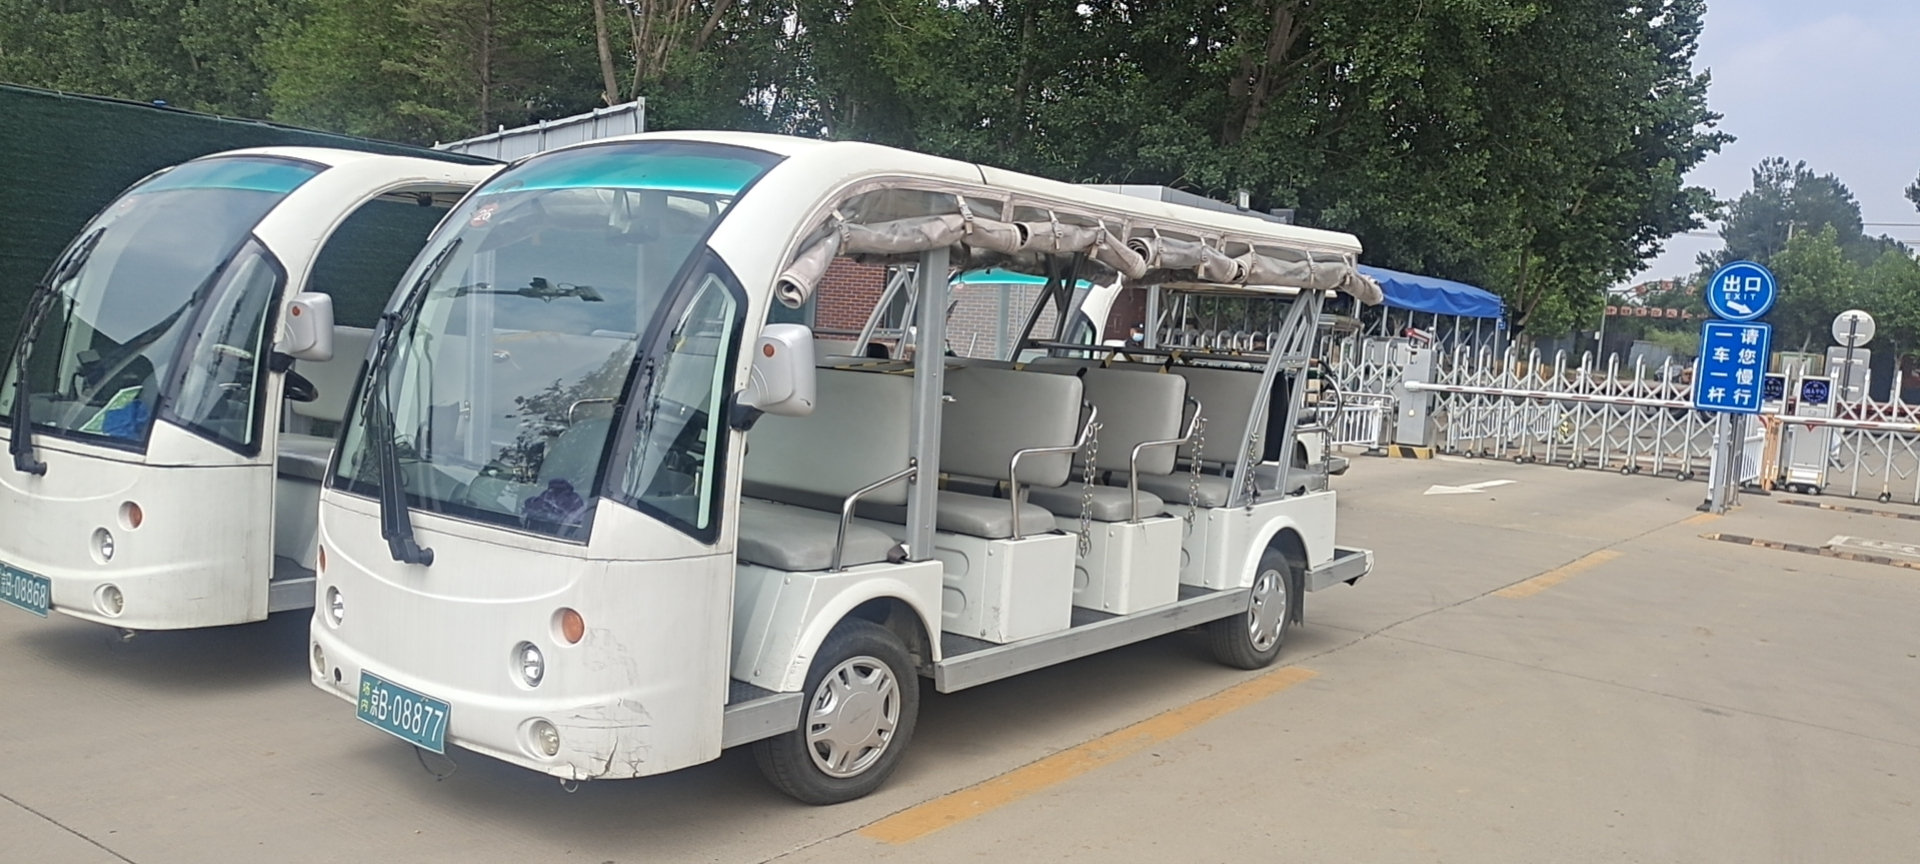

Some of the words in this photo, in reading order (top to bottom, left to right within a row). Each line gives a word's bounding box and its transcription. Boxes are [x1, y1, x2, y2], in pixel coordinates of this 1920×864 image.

[1722, 274, 1761, 292] 出口
[1725, 292, 1756, 300] EXIT
[1707, 331, 1733, 404] 一车一杆
[1733, 328, 1759, 406] 请您慢行
